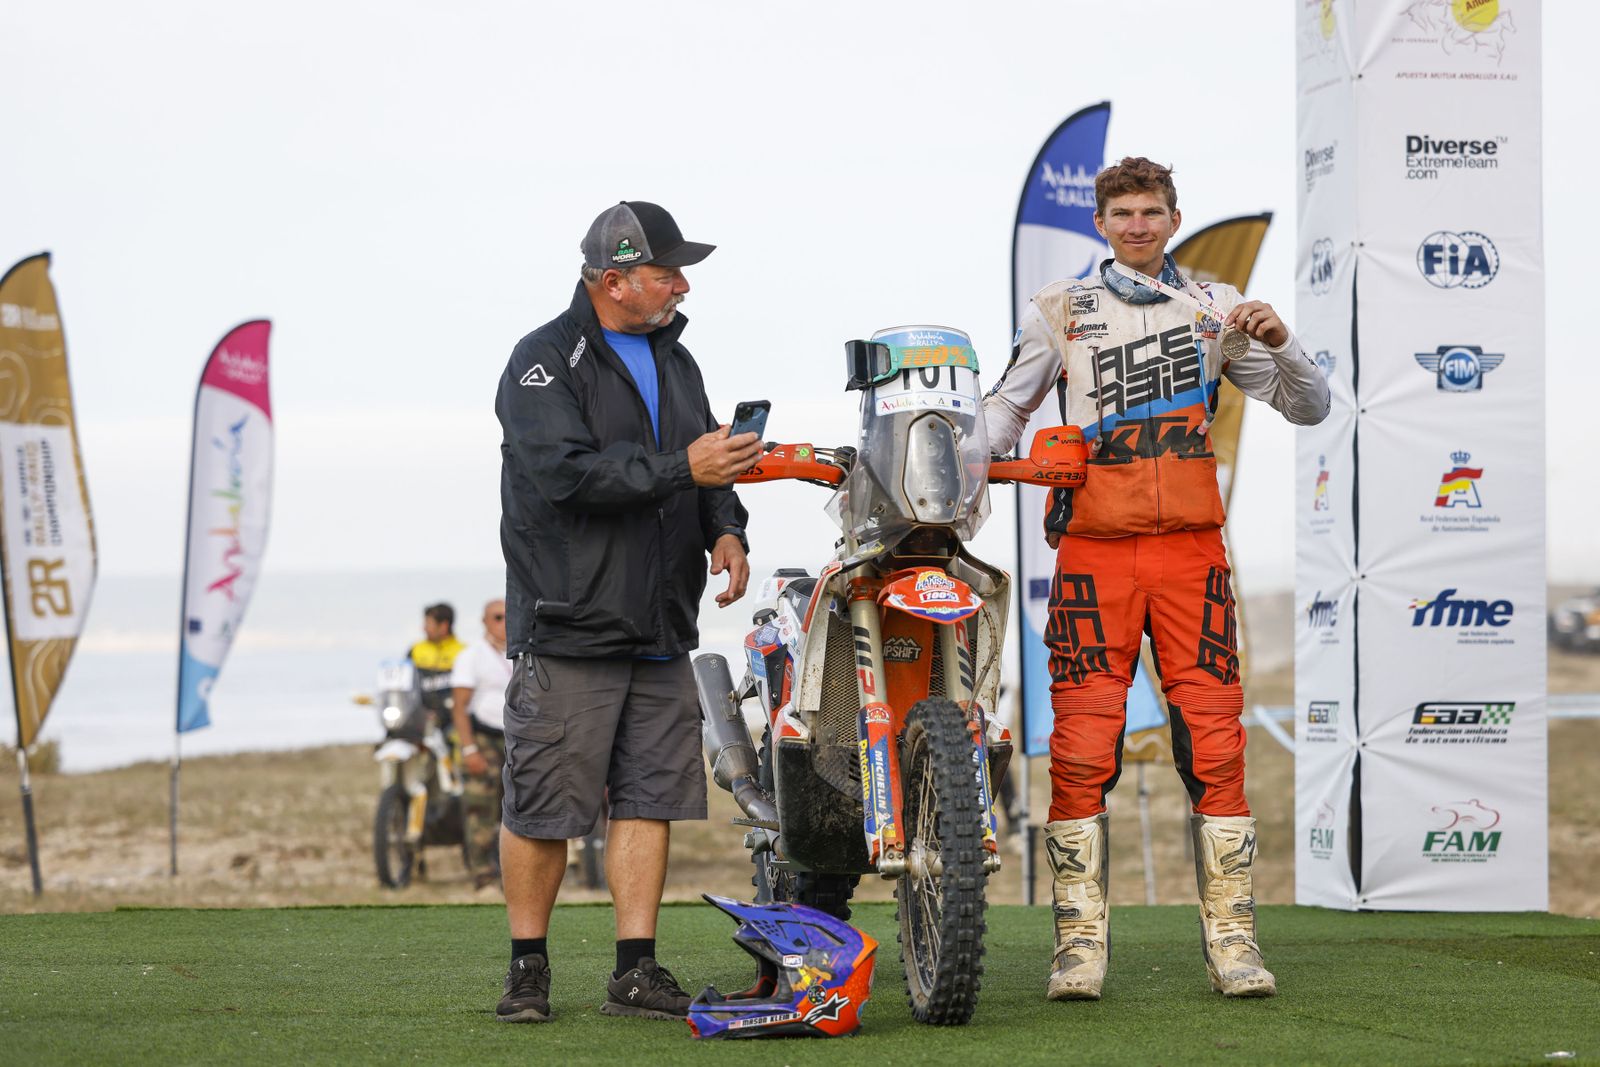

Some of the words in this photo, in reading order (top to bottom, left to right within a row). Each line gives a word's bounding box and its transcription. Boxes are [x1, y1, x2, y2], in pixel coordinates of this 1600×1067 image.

[1406, 135, 1498, 155] Diverse
[1406, 155, 1498, 169] ExtremeTeam
[1405, 168, 1438, 180] .com
[612, 251, 642, 262] WORLD
[1064, 322, 1108, 335] Landmark
[901, 345, 969, 367] 100%
[1445, 359, 1476, 379] FIM
[1099, 416, 1207, 459] KTM
[1411, 589, 1514, 627] rfme
[875, 750, 887, 809] MICHELIN
[1310, 828, 1334, 849] FAM
[1422, 831, 1502, 851] FAM
[742, 1017, 768, 1026] MASON
